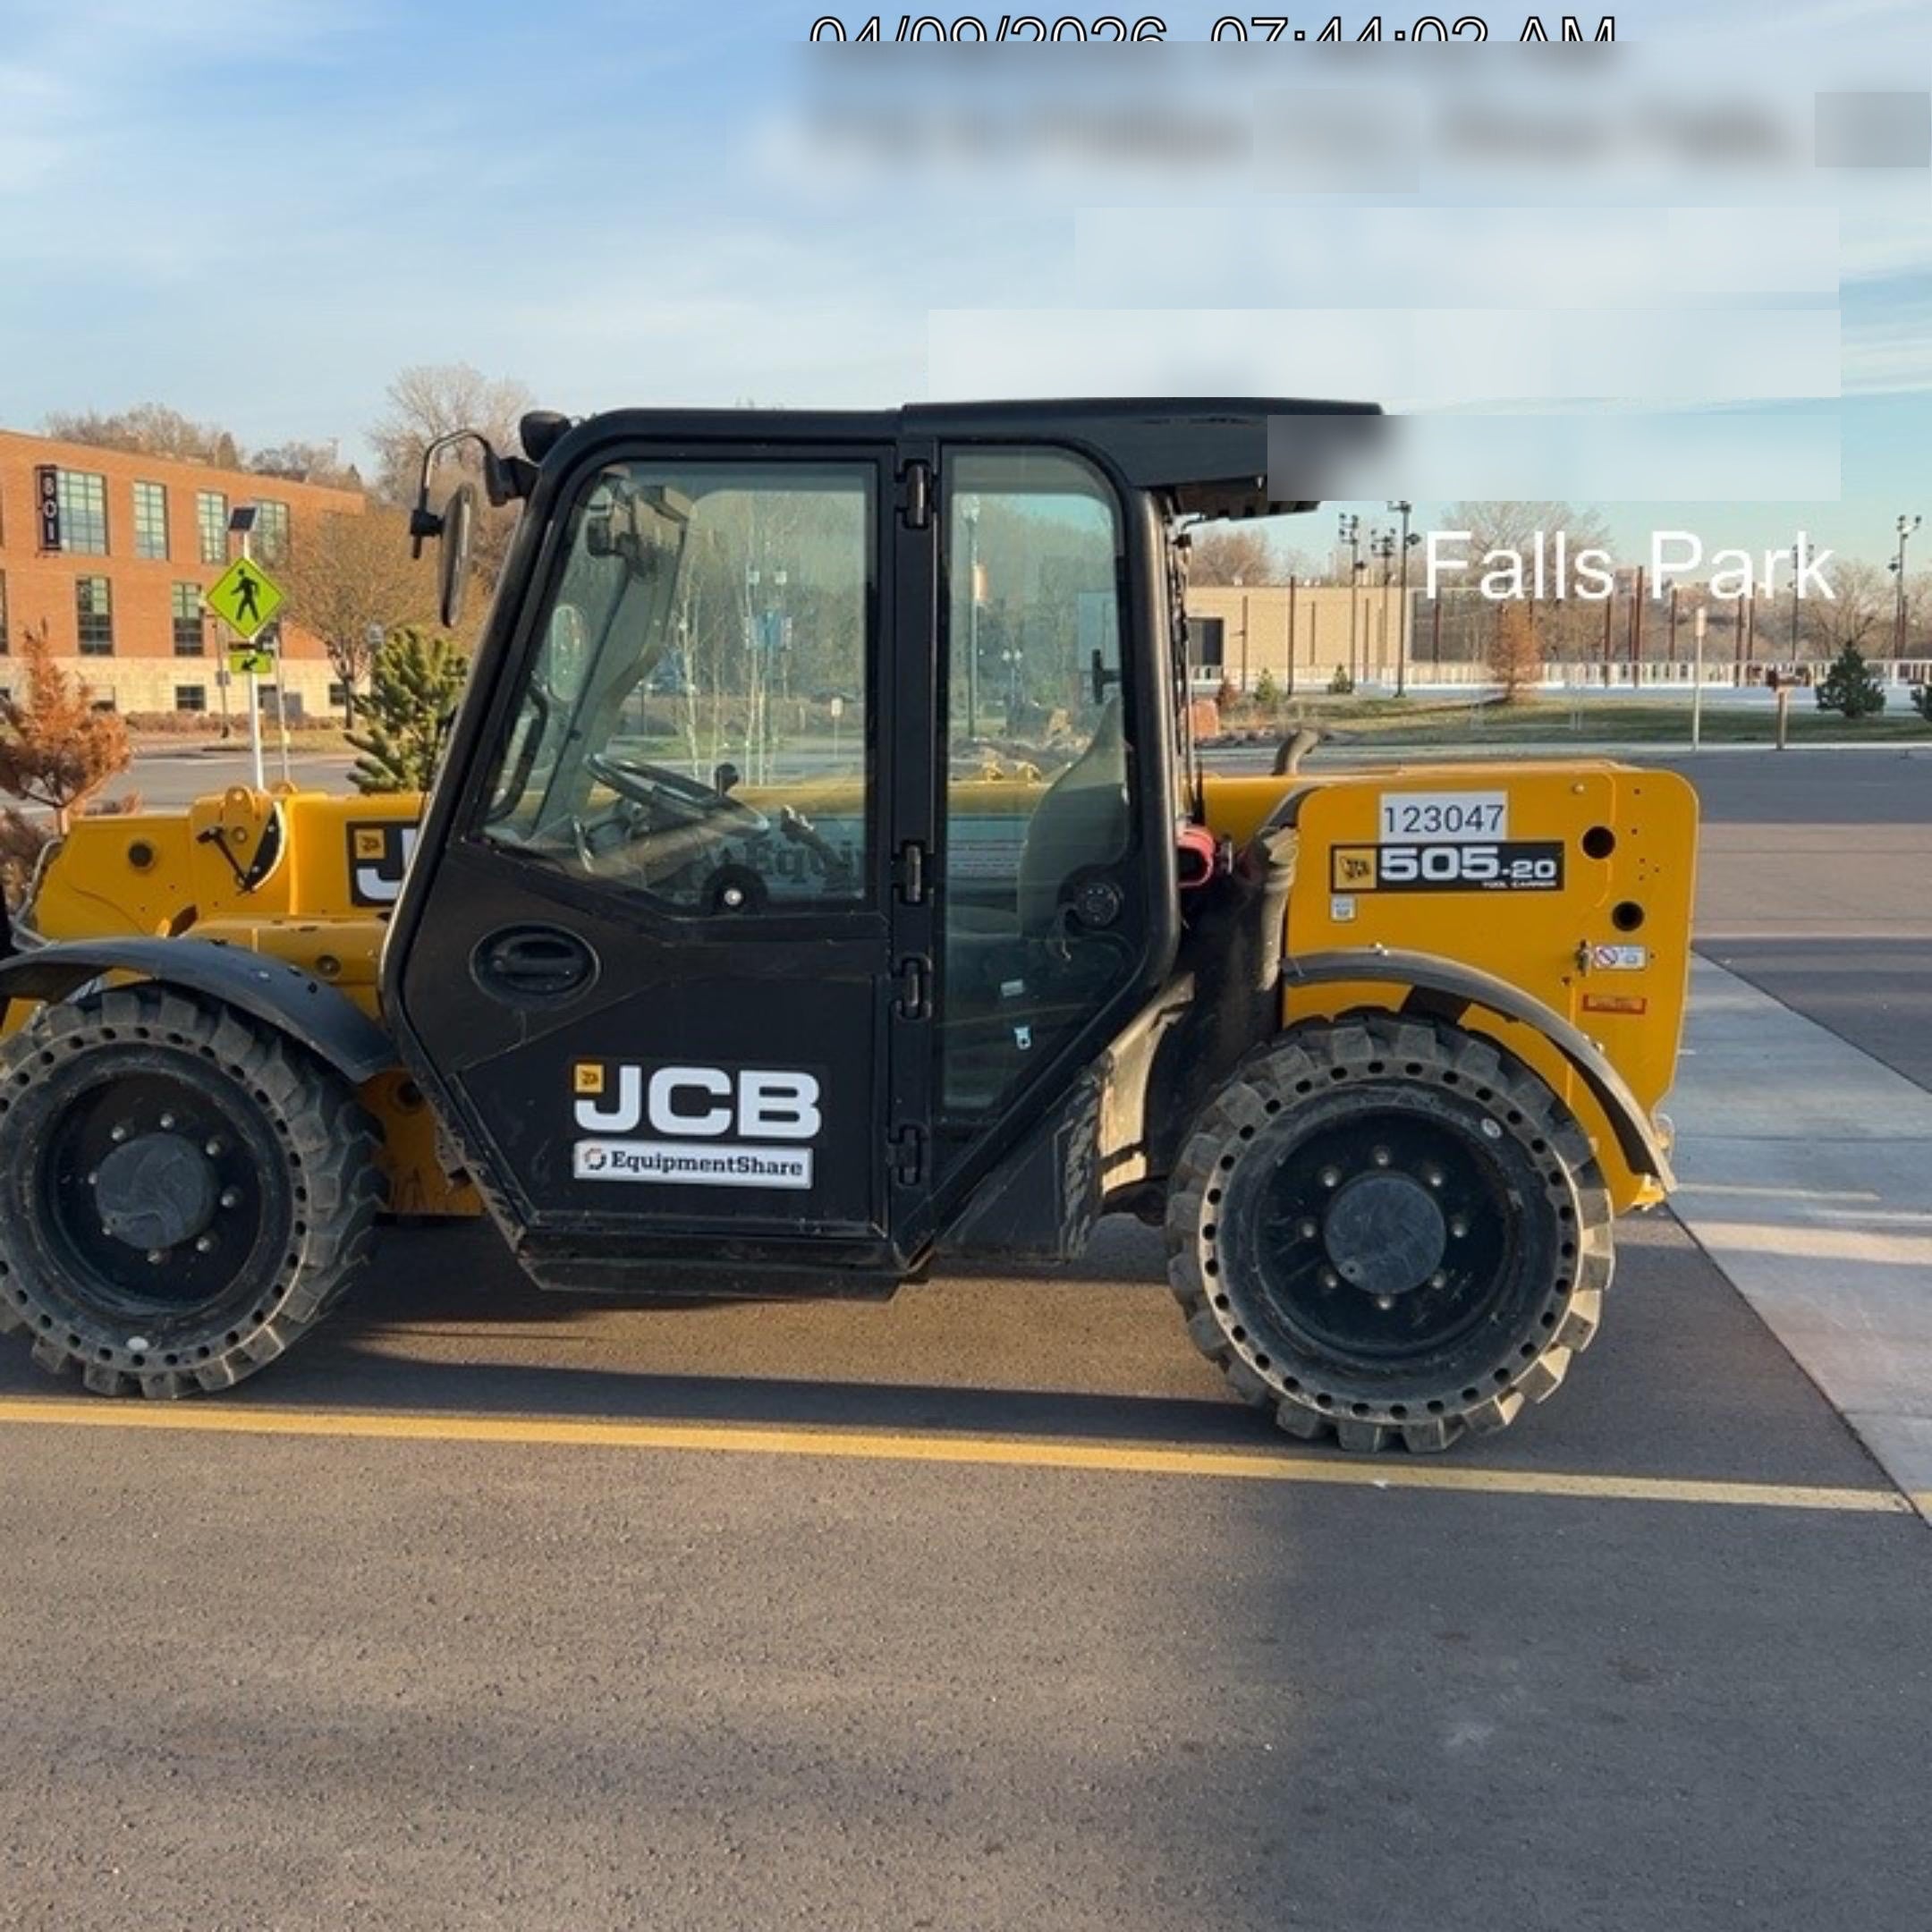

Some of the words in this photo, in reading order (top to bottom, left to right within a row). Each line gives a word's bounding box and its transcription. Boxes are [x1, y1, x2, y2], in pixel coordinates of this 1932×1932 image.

[1384, 804, 1504, 833] 123047
[574, 1064, 821, 1139] JCB
[611, 1150, 803, 1177] EquipmentShare
